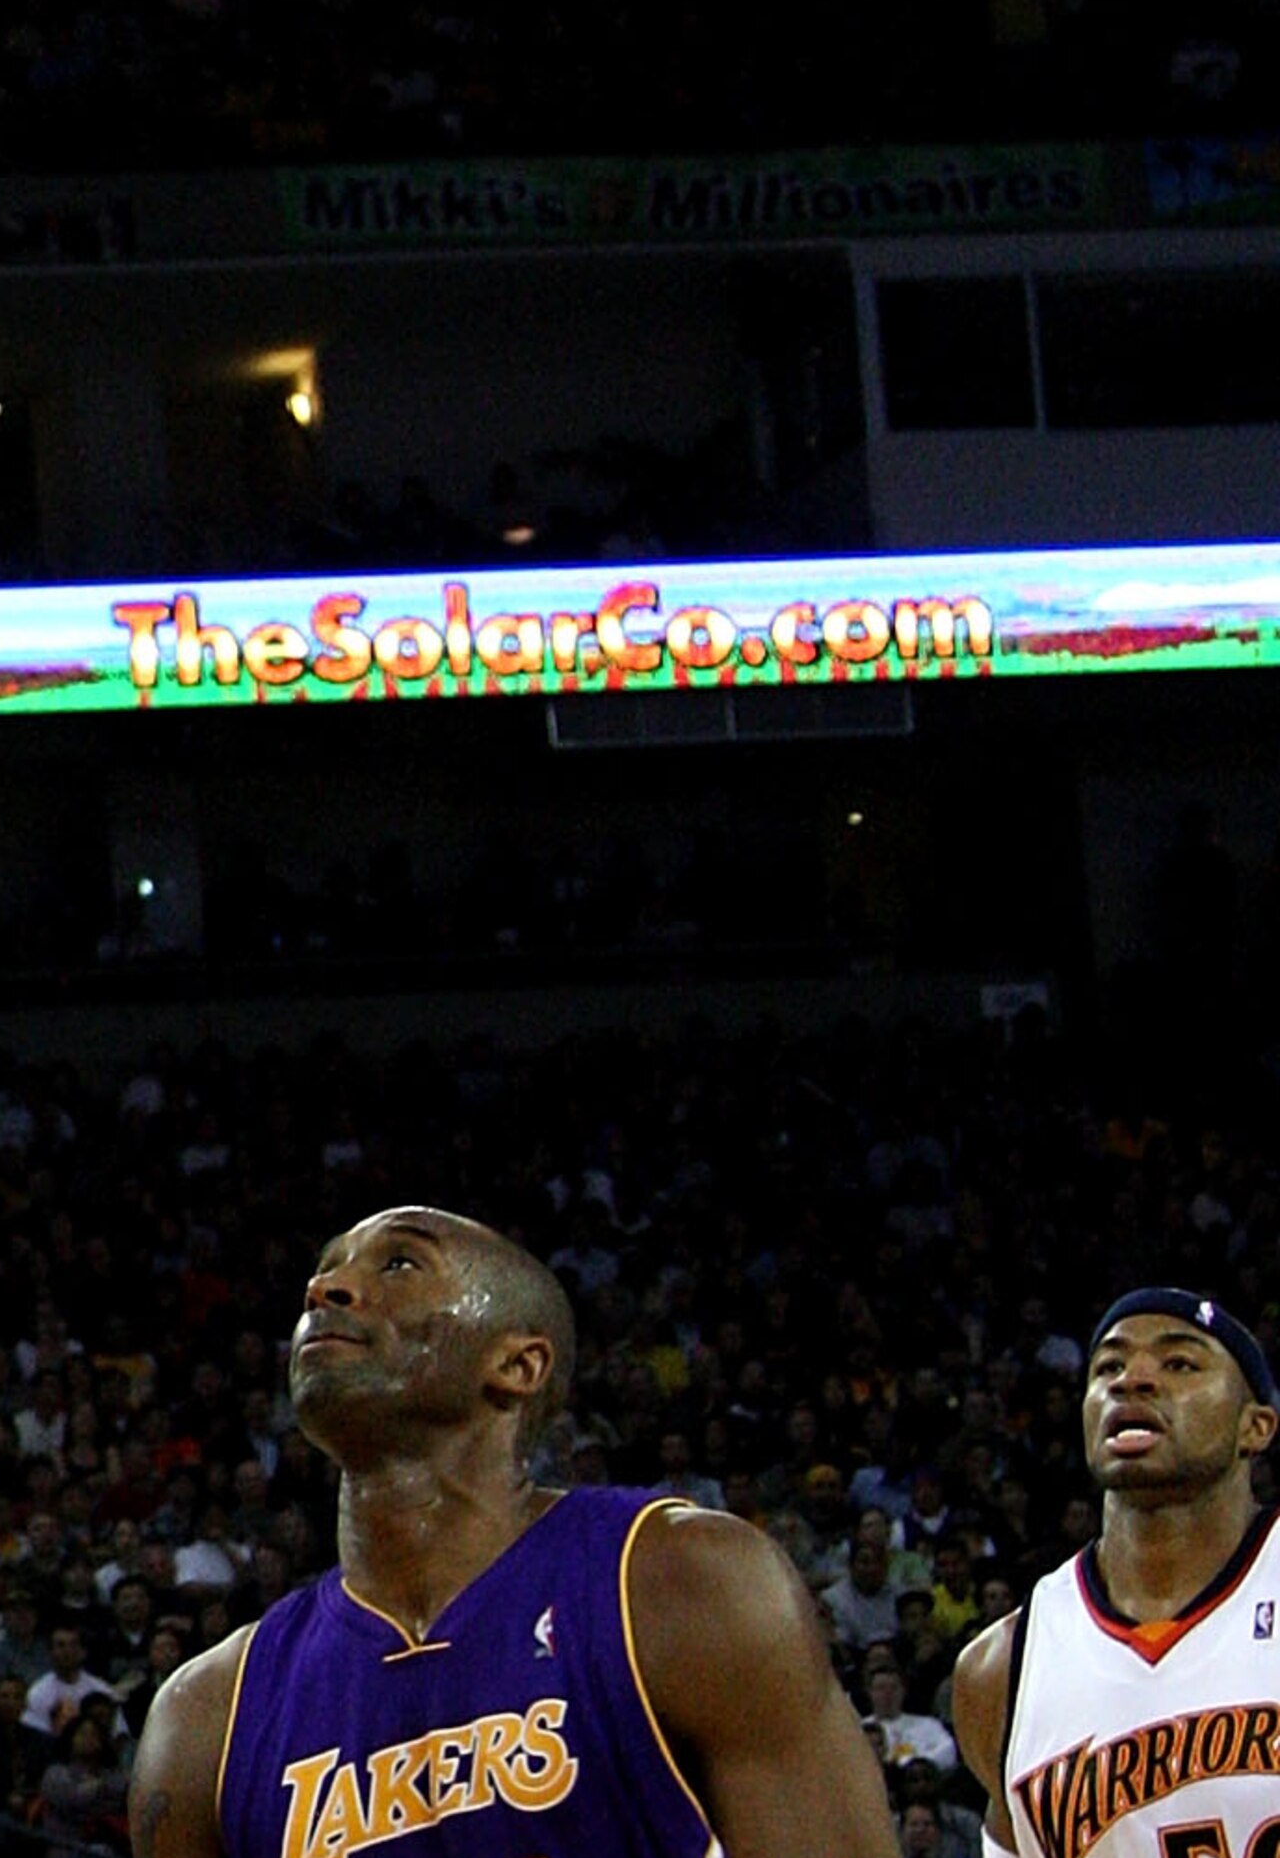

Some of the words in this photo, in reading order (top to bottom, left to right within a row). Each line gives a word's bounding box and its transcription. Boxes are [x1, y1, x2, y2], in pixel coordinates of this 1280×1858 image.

[303, 171, 570, 229] Mikki's
[648, 163, 1086, 230] Millionaires
[112, 581, 994, 688] TheSolarCo.com
